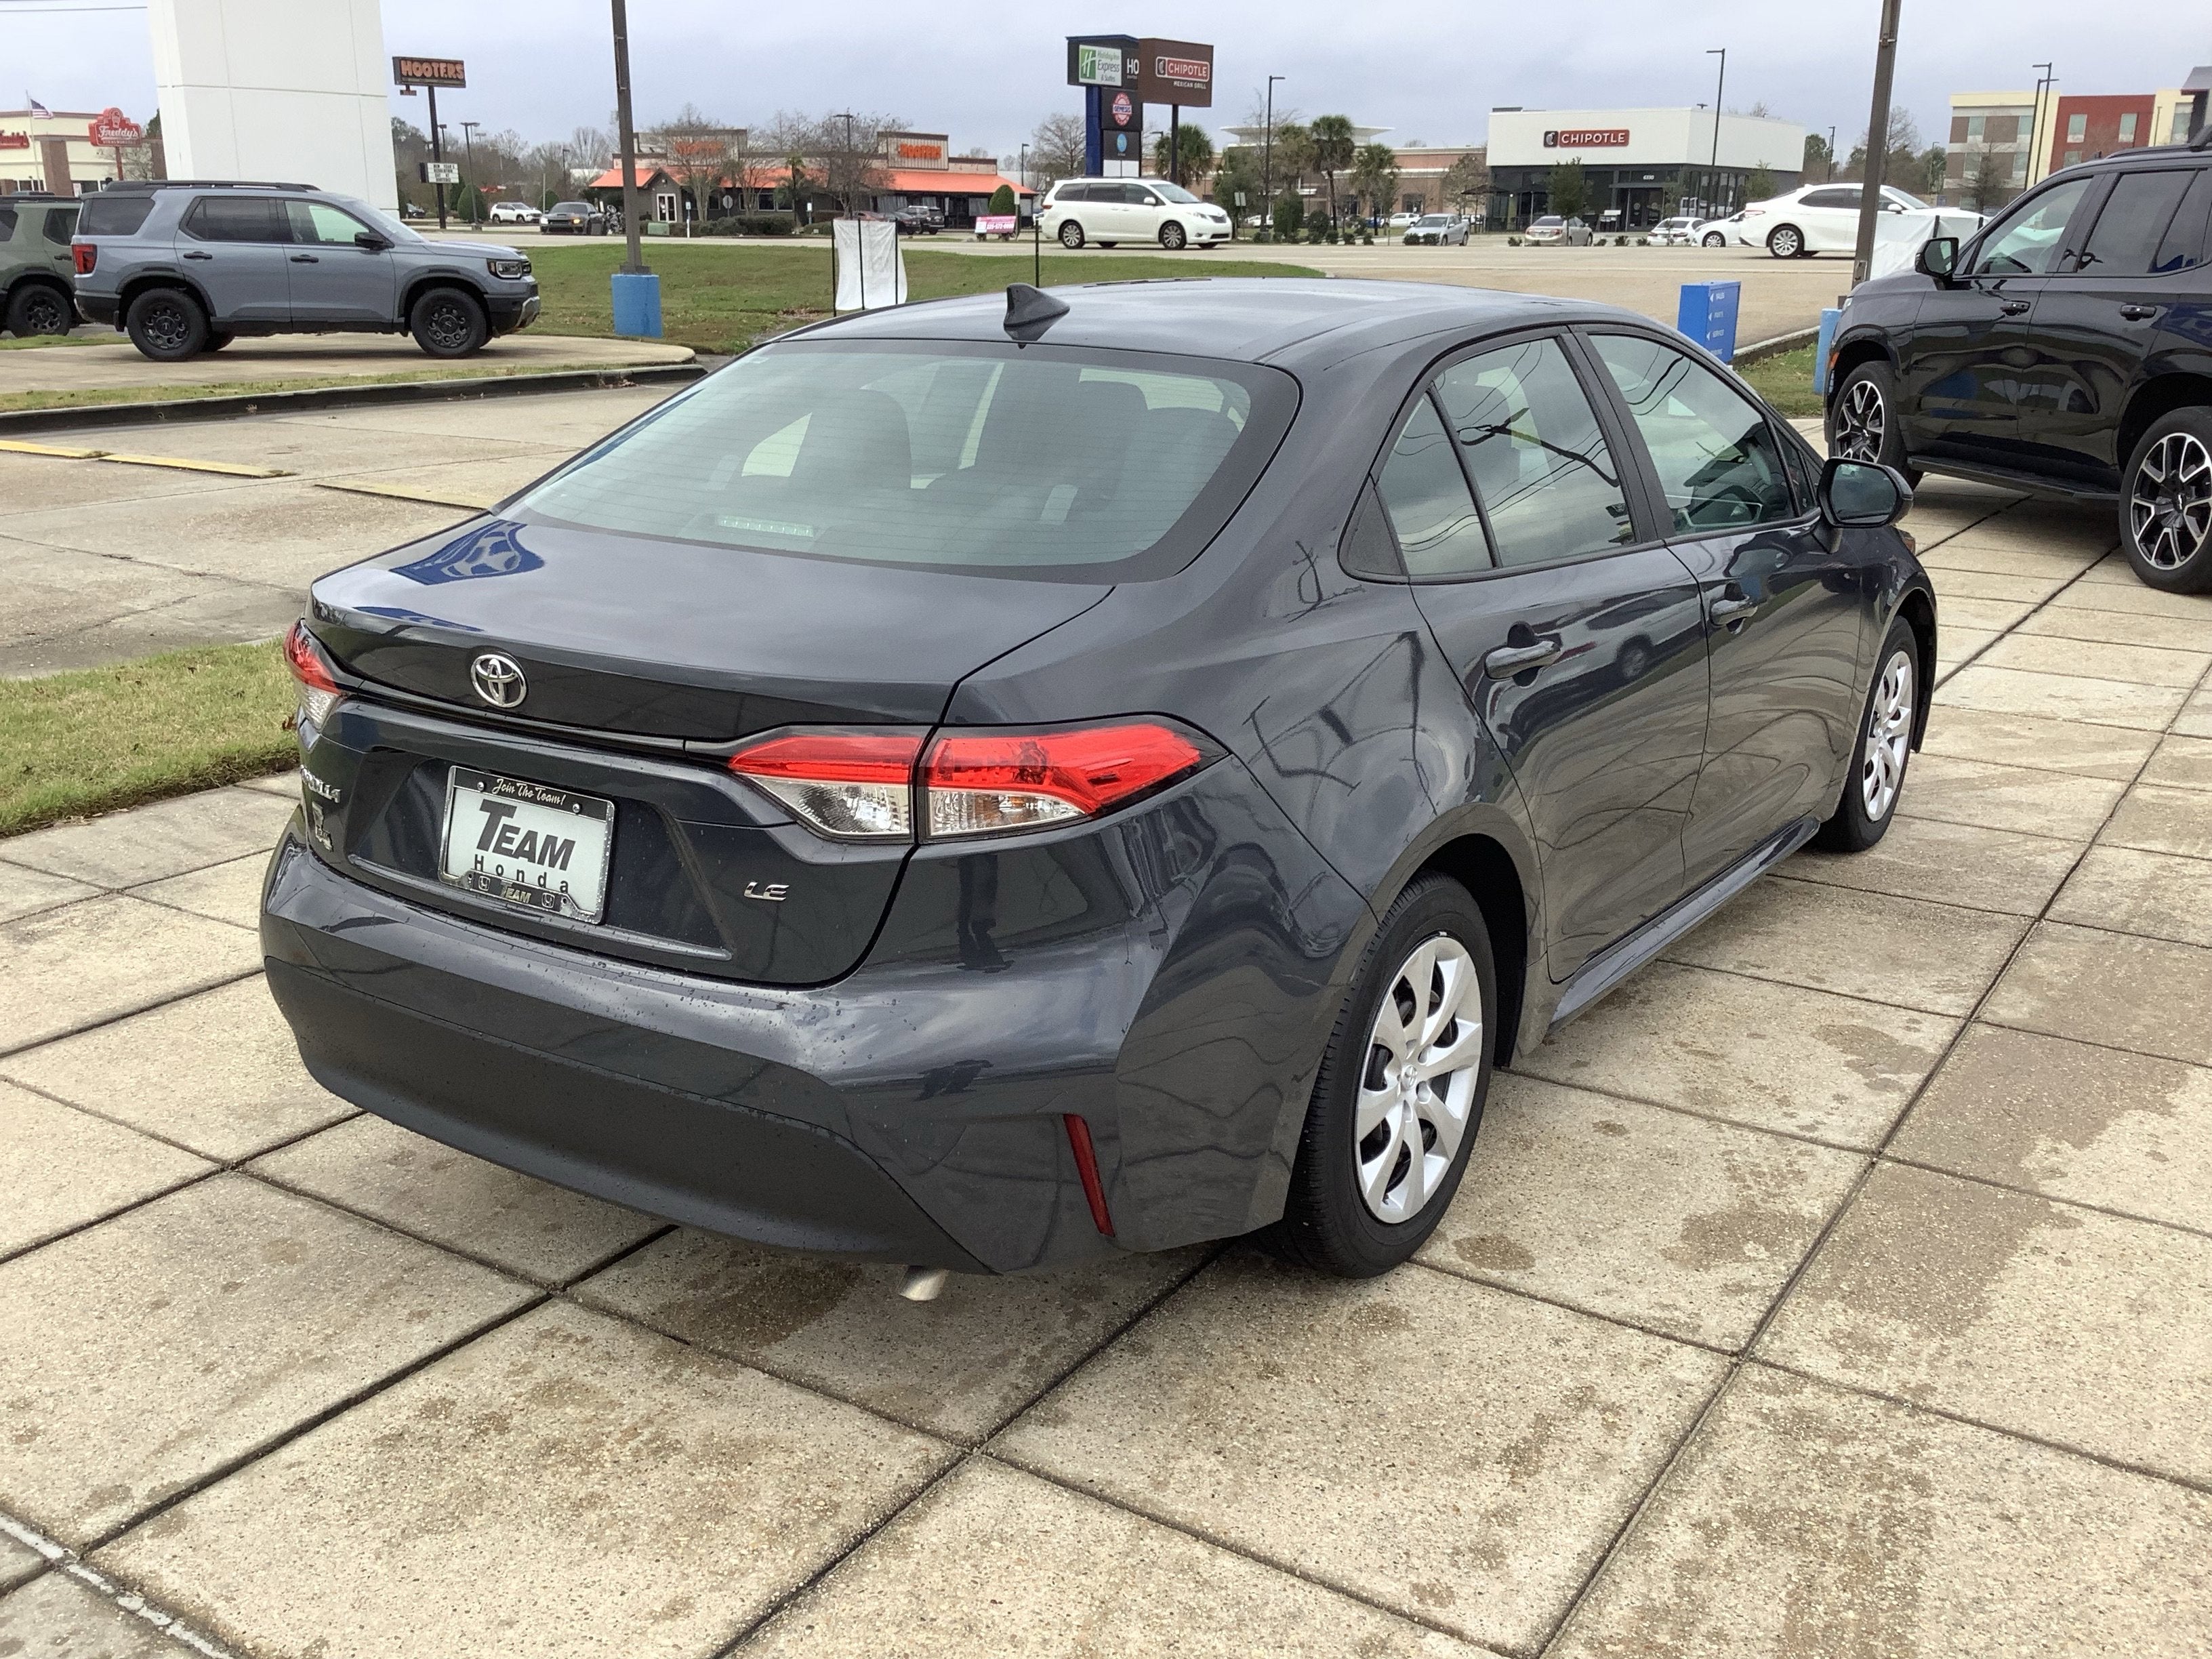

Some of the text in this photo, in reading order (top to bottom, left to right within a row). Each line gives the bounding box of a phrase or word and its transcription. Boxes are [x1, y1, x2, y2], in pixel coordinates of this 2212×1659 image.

[401, 60, 464, 79] HOOTERS
[1098, 60, 1120, 73] Express
[1168, 63, 1207, 77] CHIPOTLE
[98, 126, 139, 141] Freddy's
[1561, 133, 1625, 144] CHIPOTLE
[492, 779, 567, 805] Join The Team!
[744, 882, 789, 901] LE
